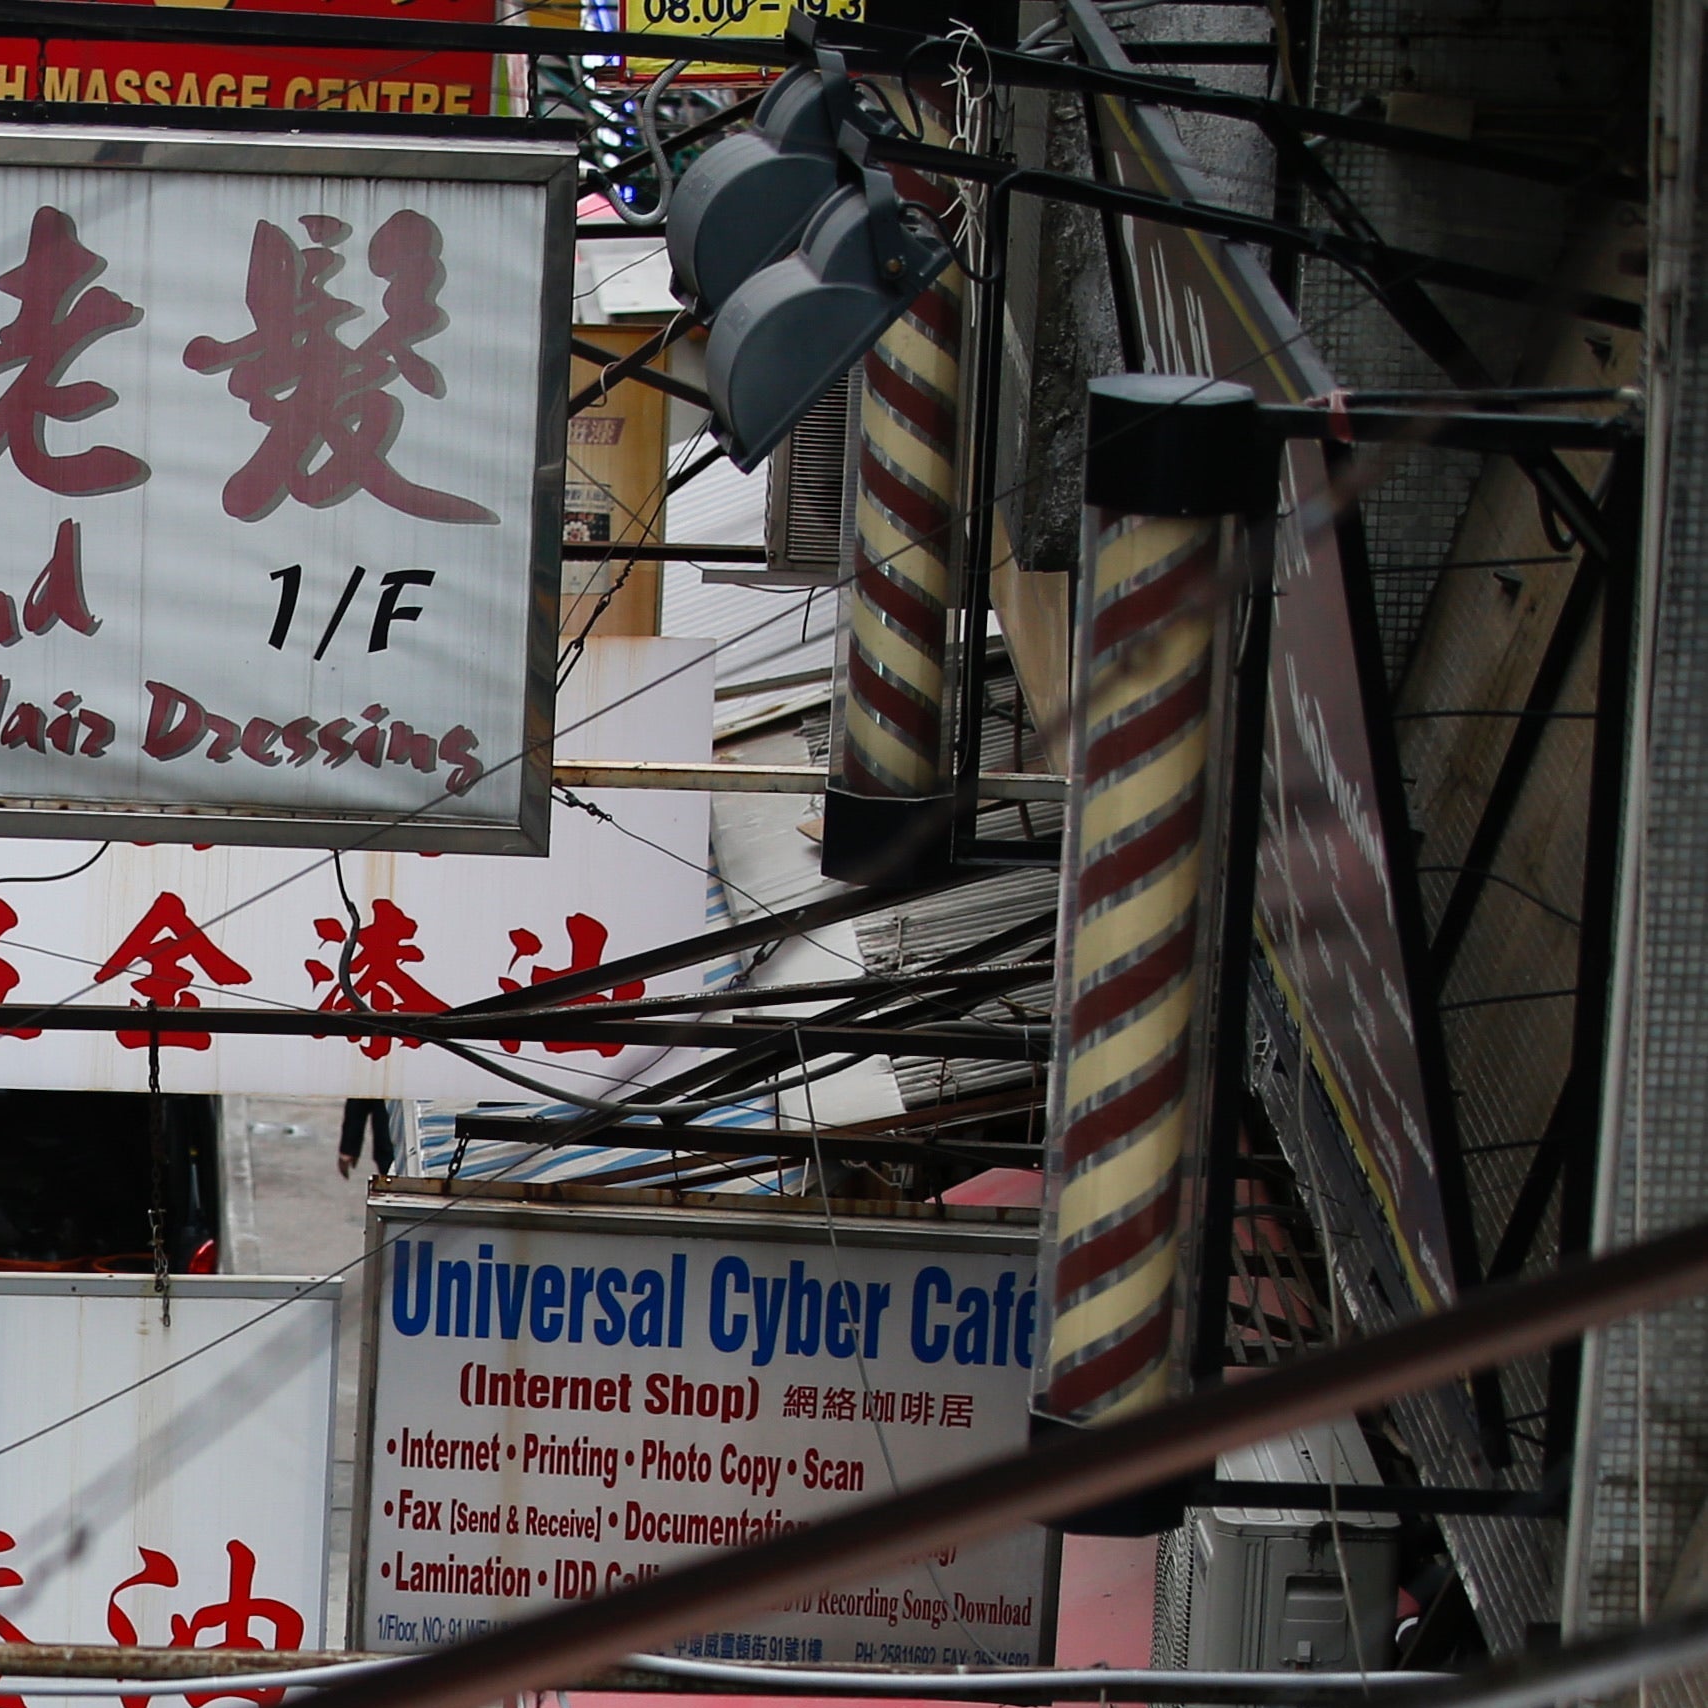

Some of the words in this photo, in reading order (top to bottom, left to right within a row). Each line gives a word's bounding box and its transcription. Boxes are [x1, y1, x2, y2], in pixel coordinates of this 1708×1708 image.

[44, 66, 270, 108] MASSAGE
[284, 75, 473, 117] CENTRE
[267, 564, 437, 661] 1/F
[392, 1240, 688, 1349] Universal
[709, 1255, 890, 1368] Cyber
[459, 1361, 633, 1413] (Internet
[644, 1372, 761, 1424] Shop)
[401, 1427, 501, 1472] Internet
[522, 1433, 619, 1488] Printing
[641, 1439, 712, 1483] Photo
[720, 1443, 782, 1497] Copy
[803, 1448, 864, 1491] Scan
[398, 1489, 442, 1531] Fax
[506, 1505, 520, 1535] &
[395, 1551, 531, 1597] Lamination
[817, 1587, 899, 1627] Recording
[902, 1589, 948, 1630] Songs
[953, 1592, 1032, 1627] Download
